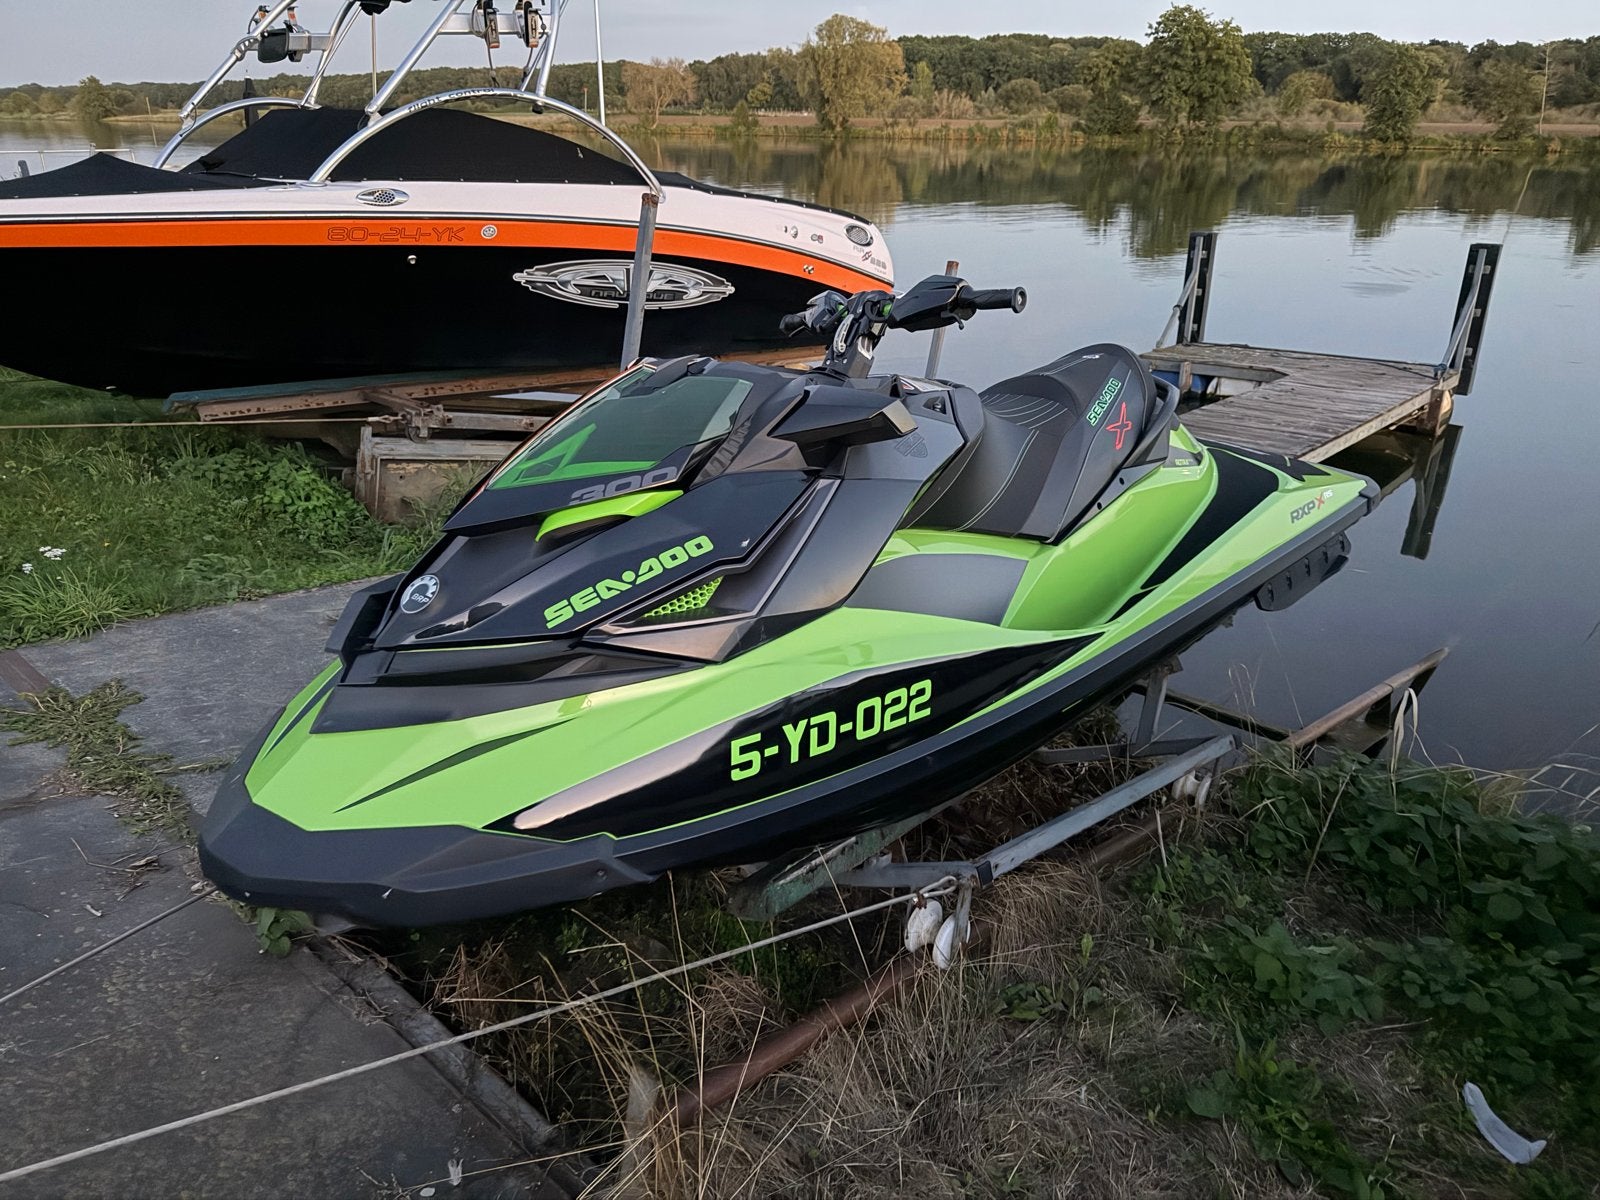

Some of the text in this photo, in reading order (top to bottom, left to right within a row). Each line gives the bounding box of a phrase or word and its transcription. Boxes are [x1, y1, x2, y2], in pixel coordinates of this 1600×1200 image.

[327, 226, 466, 242] 80-24-YK
[567, 466, 678, 505] 300
[411, 593, 430, 603] BRP
[730, 679, 932, 782] 5-YD-022
